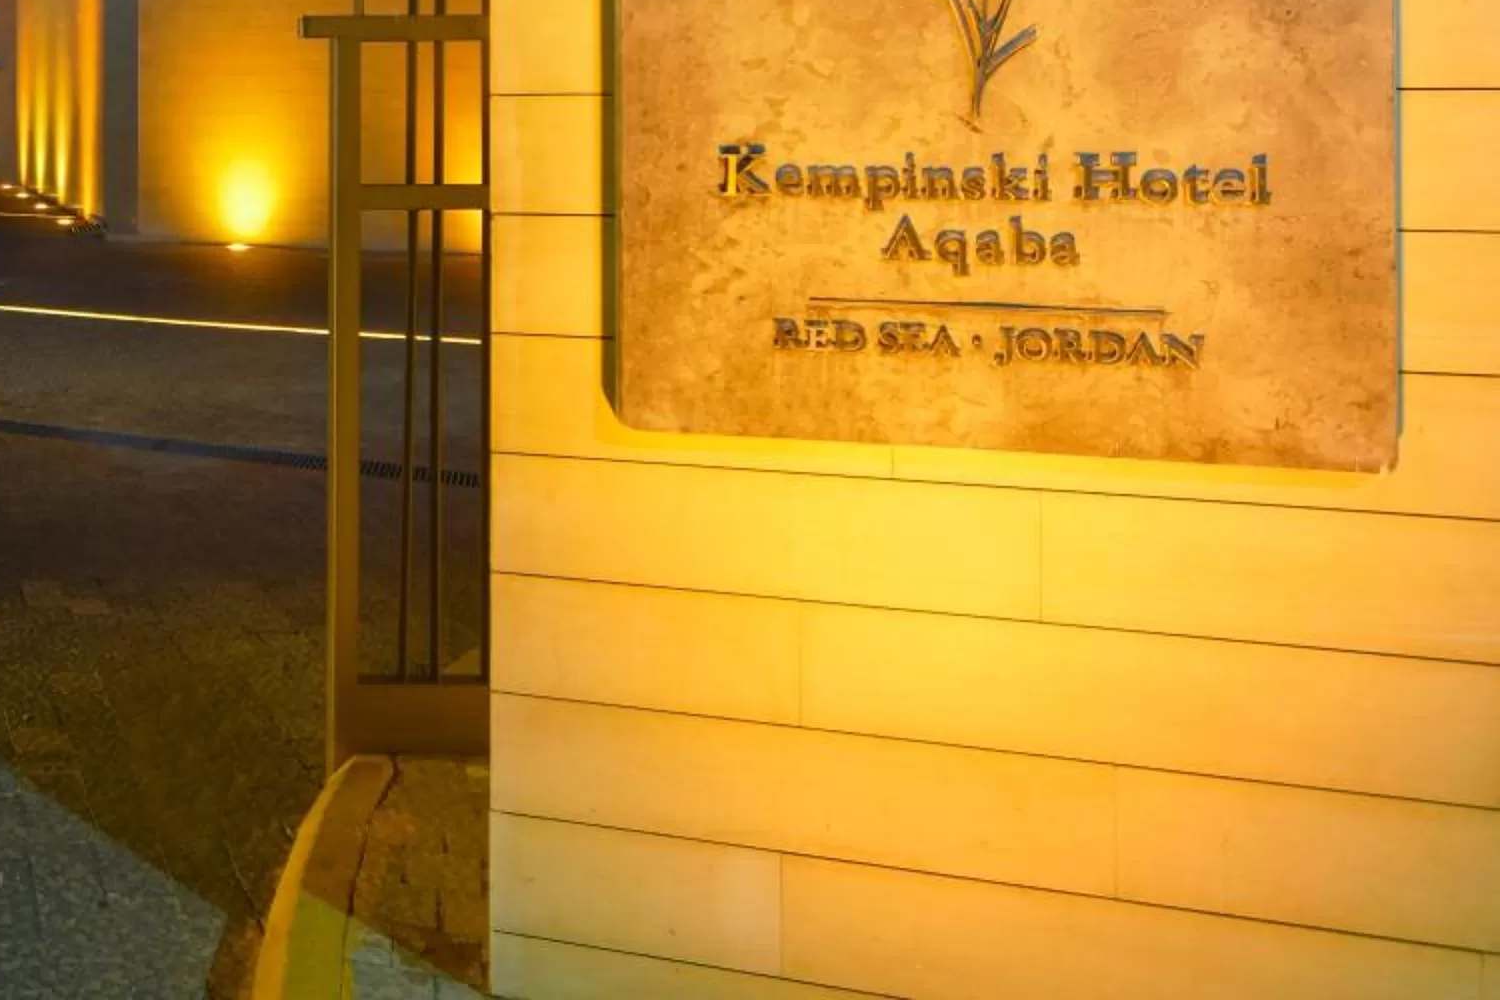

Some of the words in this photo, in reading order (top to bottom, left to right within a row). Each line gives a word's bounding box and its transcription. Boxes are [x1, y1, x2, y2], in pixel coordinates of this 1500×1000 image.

[717, 143, 1052, 211] Kempinski
[1072, 151, 1272, 206] Hotel
[880, 213, 1080, 276] Aqaba
[772, 317, 867, 352] RED
[877, 321, 961, 357] SEA
[993, 325, 1205, 369] JORDAN
